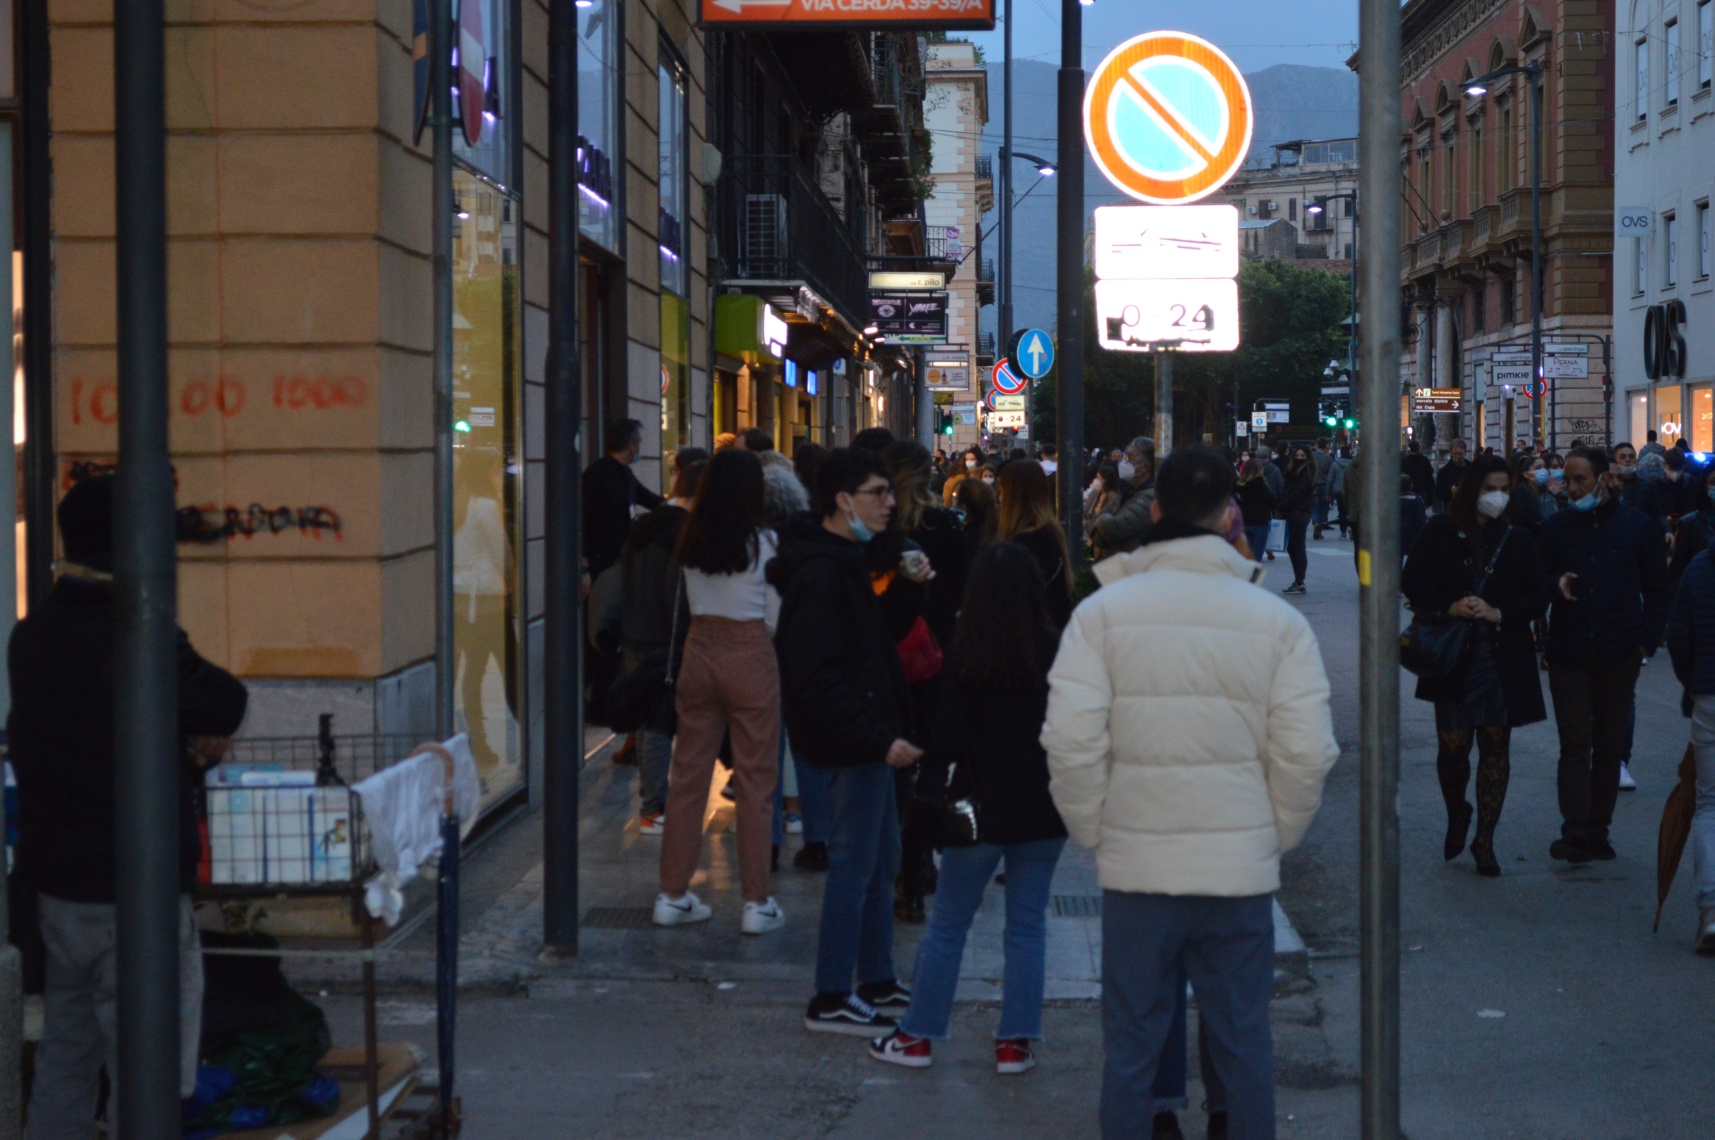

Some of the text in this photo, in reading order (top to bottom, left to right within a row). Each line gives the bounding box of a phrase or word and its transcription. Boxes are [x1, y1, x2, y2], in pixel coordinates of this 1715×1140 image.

[803, 0, 983, 12] VIA CERDA 39-39/A
[1622, 216, 1648, 228] OVS
[925, 278, 940, 287] pilo
[1644, 300, 1687, 381] OVS
